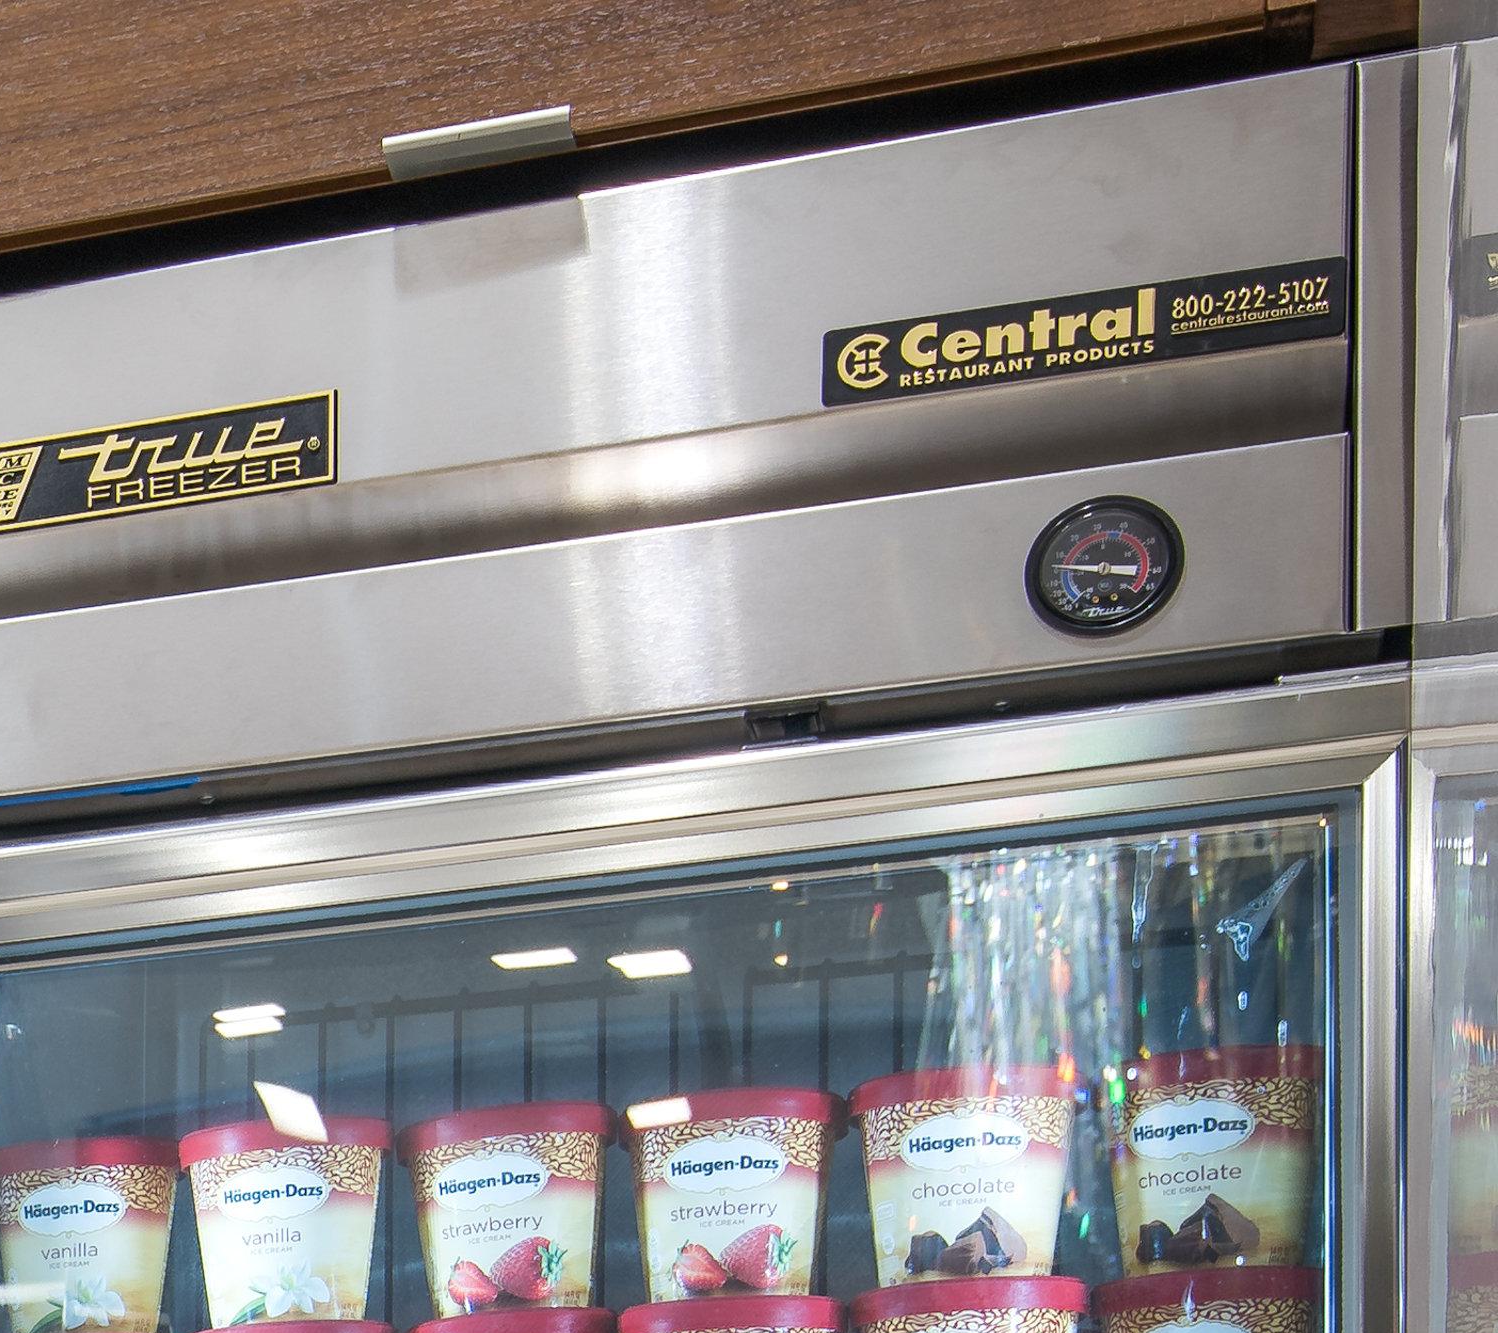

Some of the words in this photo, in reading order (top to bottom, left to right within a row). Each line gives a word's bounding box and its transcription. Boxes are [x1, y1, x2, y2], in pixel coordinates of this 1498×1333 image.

[902, 288, 1157, 367] Central
[1171, 277, 1331, 318] 800-222-5107
[1171, 300, 1331, 330] centralrestaurant.com
[899, 356, 1035, 388] RESTAURANT
[1045, 340, 1156, 367] PRODUCTS
[86, 456, 302, 509] FREEZER
[1132, 1114, 1249, 1144] Häagen-Dazs
[907, 1130, 1023, 1154] Häagen-Dazs
[670, 1155, 781, 1180] Häagen-Dazs
[1138, 1162, 1242, 1187] chocolate
[223, 1181, 324, 1205] Häagen-Dazs
[438, 1167, 542, 1198] Häagen-Dazs
[911, 1176, 1015, 1201] chocolate
[23, 1198, 121, 1220] Häagen-Dazs
[669, 1199, 779, 1222] strawberry
[241, 1227, 302, 1247] vanilla
[441, 1213, 543, 1239] strawberry
[41, 1240, 99, 1260] vanilla
